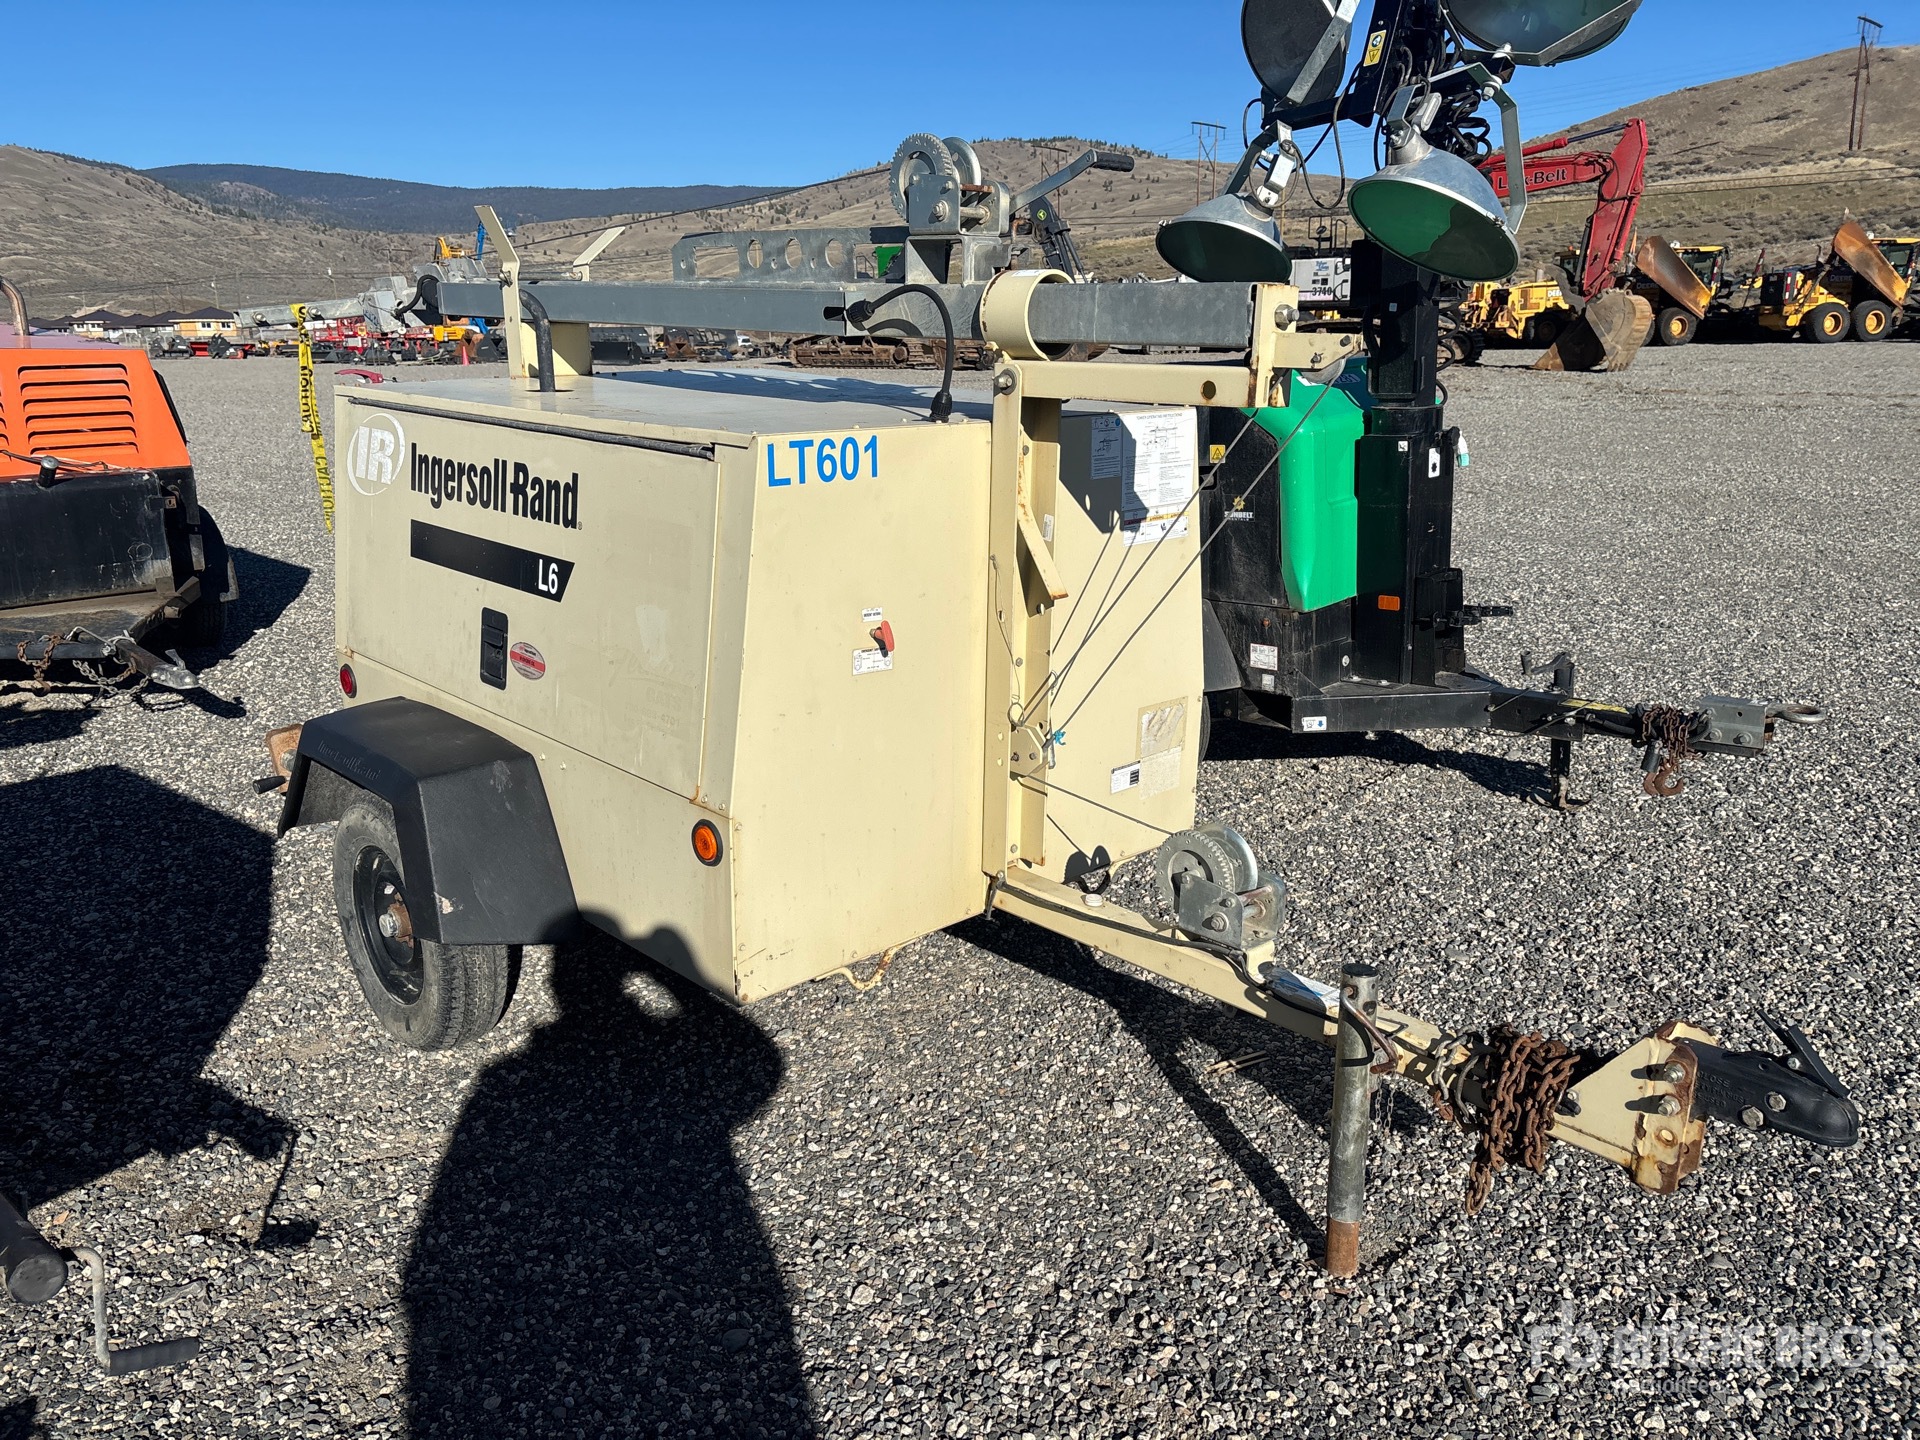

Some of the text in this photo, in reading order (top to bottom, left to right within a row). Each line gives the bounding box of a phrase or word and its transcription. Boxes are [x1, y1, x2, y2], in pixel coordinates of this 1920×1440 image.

[1498, 168, 1567, 190] Lk-Belt
[1312, 286, 1332, 297] 3740
[356, 425, 396, 485] IR
[767, 435, 878, 487] LT601
[410, 442, 579, 530] Ingersoll-Rand
[537, 558, 558, 595] L6
